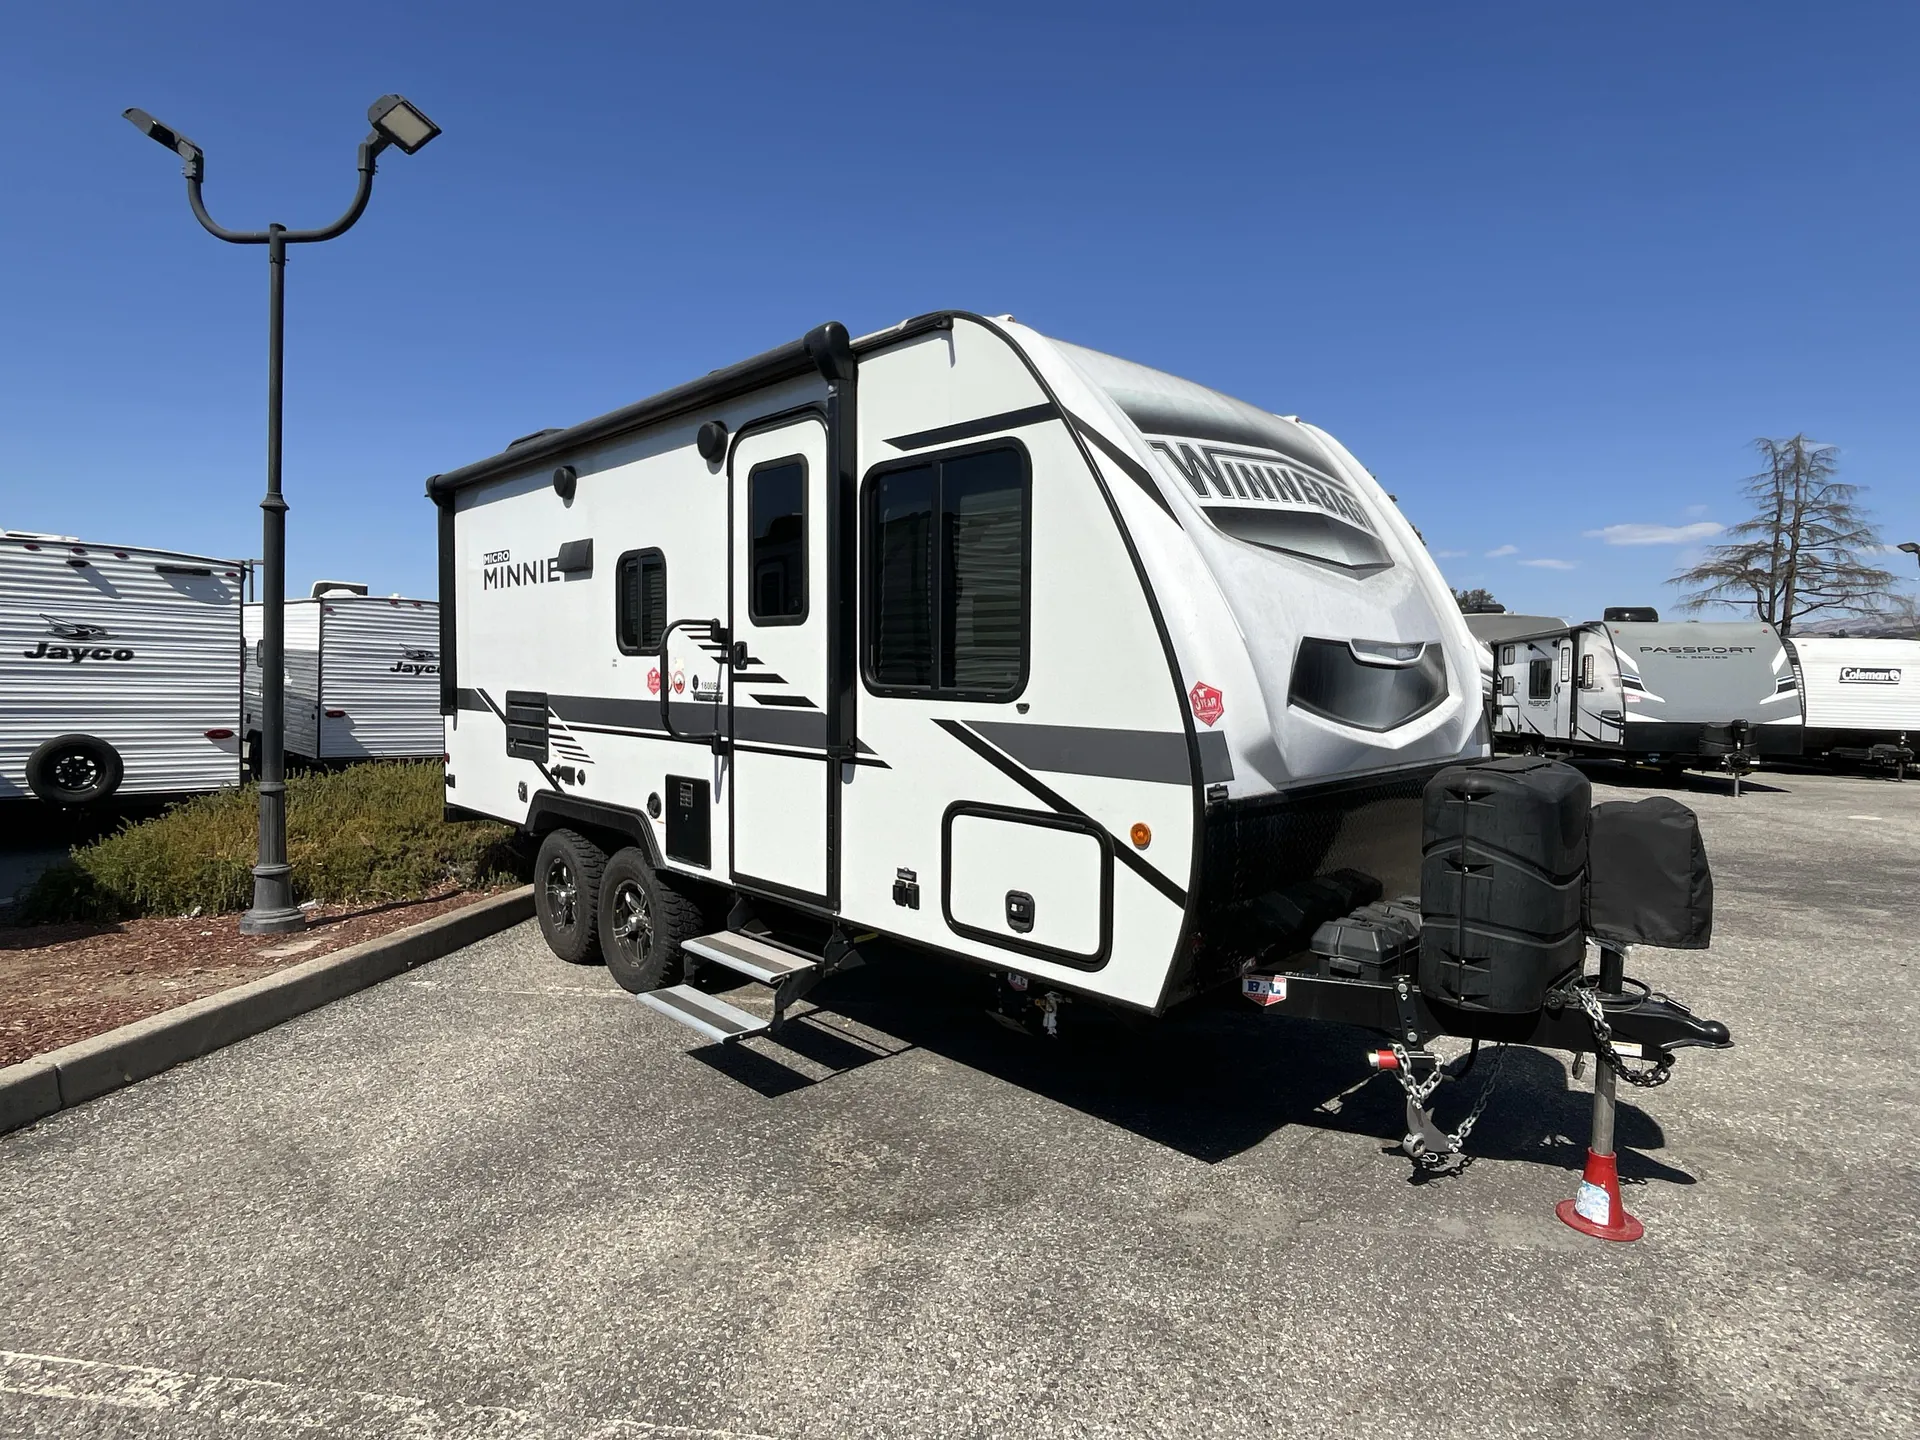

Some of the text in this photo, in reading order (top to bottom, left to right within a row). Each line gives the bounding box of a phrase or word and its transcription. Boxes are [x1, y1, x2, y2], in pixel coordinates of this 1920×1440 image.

[484, 550, 510, 565] MICRO
[483, 557, 561, 590] MINNIE
[23, 641, 135, 663] Jayco
[1639, 646, 1756, 654] PASSPORT
[1841, 668, 1889, 681] Coleman
[1200, 697, 1217, 708] YEAR
